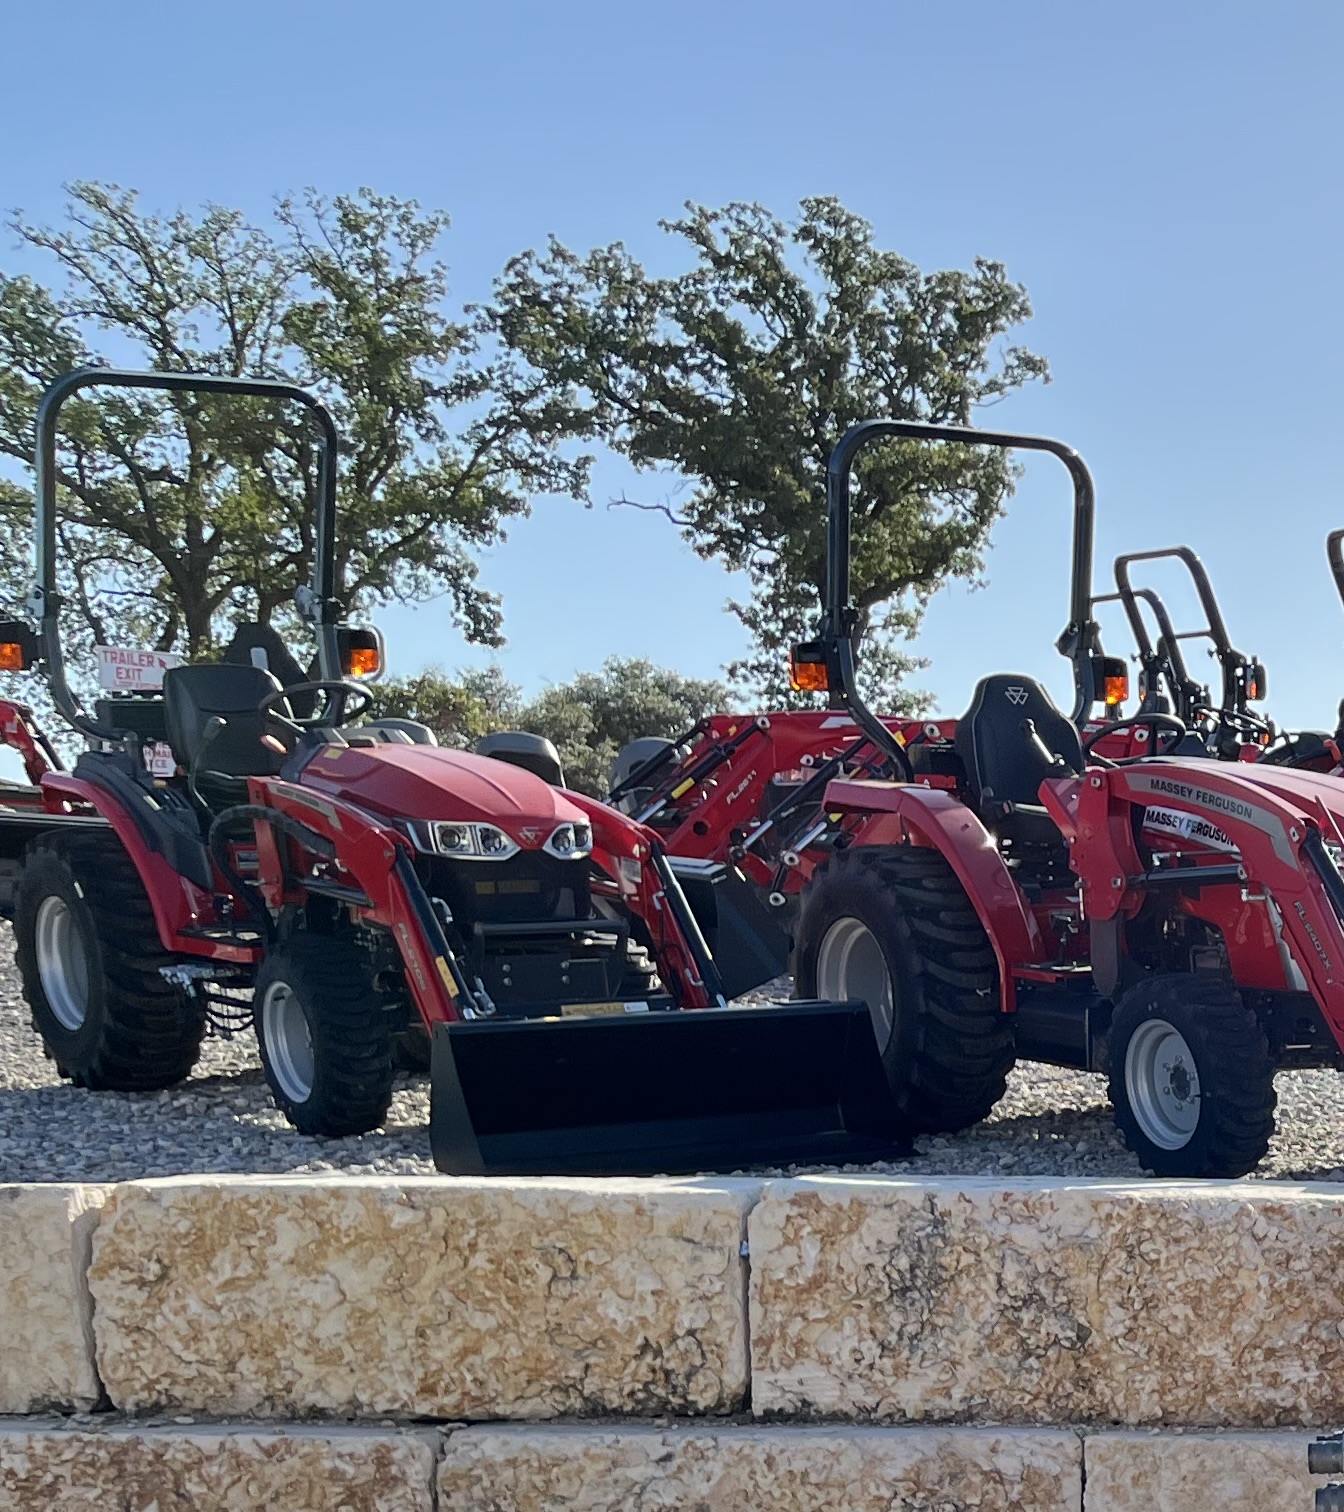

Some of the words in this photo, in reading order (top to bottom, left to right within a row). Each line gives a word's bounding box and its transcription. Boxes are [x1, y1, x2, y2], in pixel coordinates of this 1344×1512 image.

[103, 650, 155, 668] TRAILER
[115, 666, 143, 681] EXIT
[1150, 778, 1194, 799] MASSEY
[1196, 790, 1253, 819] FERGUSON
[1145, 809, 1183, 828] MASSEY
